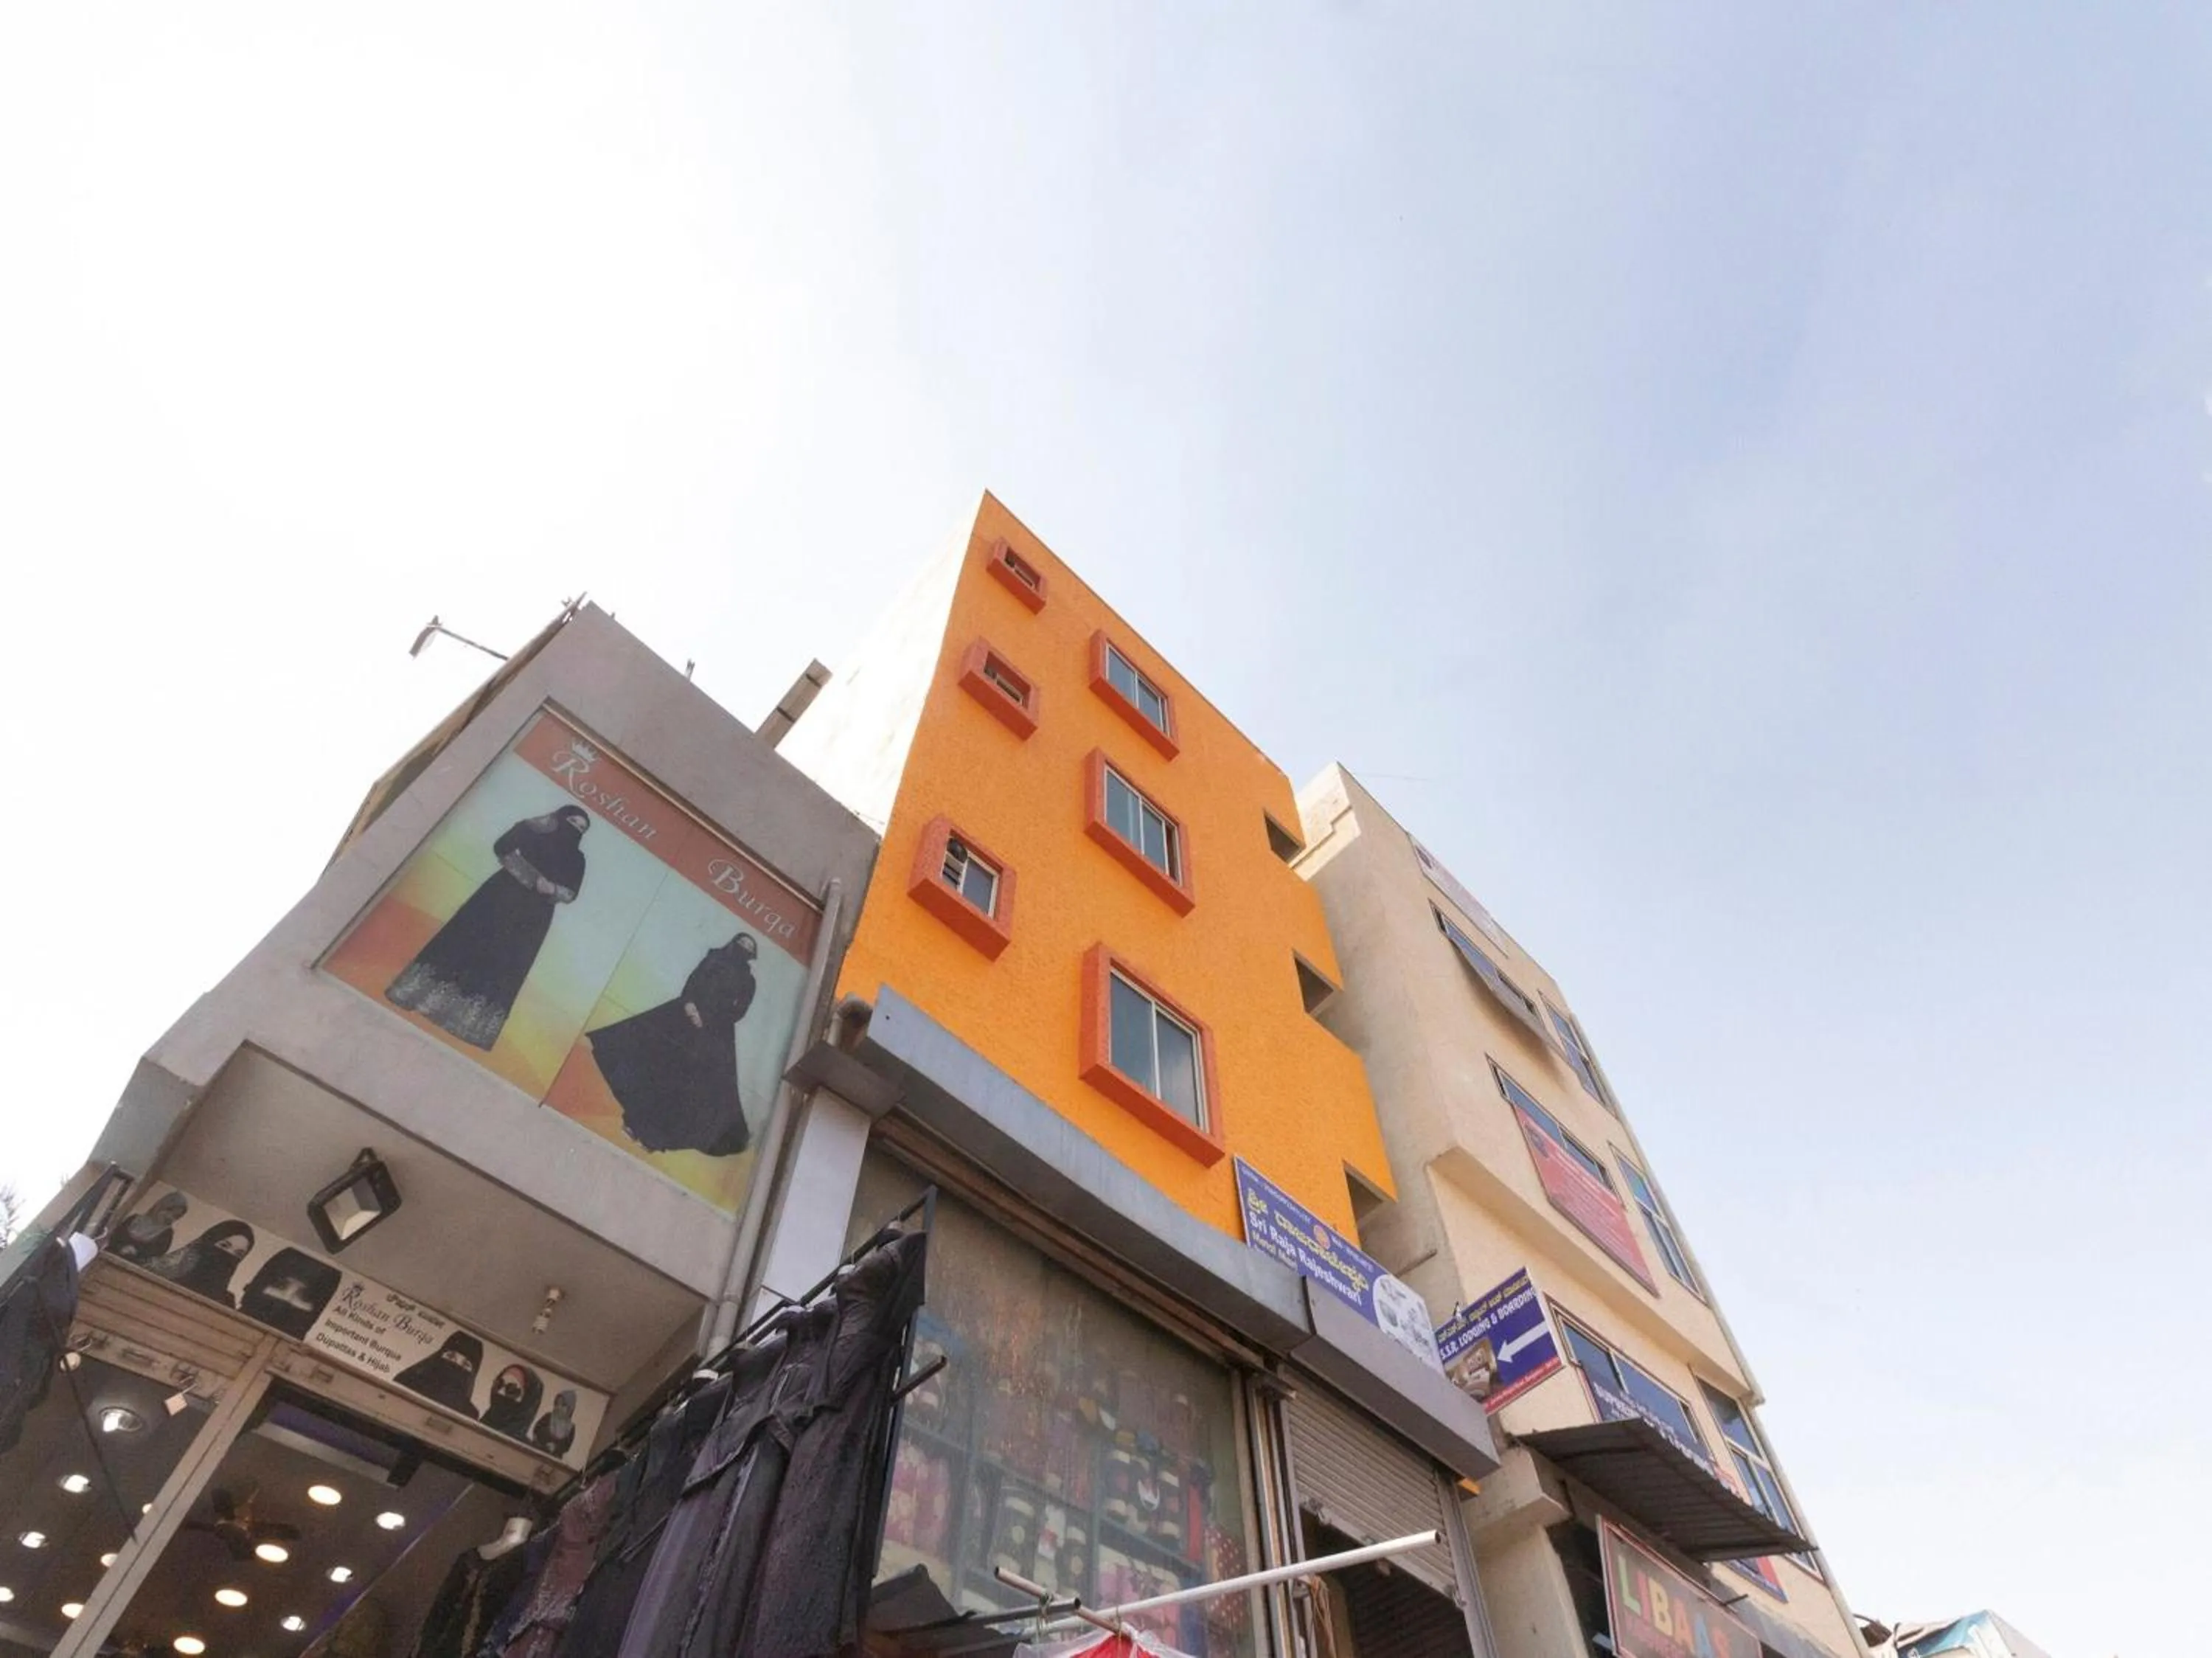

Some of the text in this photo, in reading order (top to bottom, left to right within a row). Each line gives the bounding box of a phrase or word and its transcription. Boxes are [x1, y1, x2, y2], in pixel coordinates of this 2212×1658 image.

[552, 749, 797, 939] Roshan Burqa
[1249, 1212, 1267, 1235] Sri
[1270, 1225, 1297, 1258] Raja
[333, 1305, 386, 1335] All Kinds of
[342, 1286, 391, 1322] Roshan
[358, 1353, 366, 1362] &
[367, 1356, 391, 1373] Hijab
